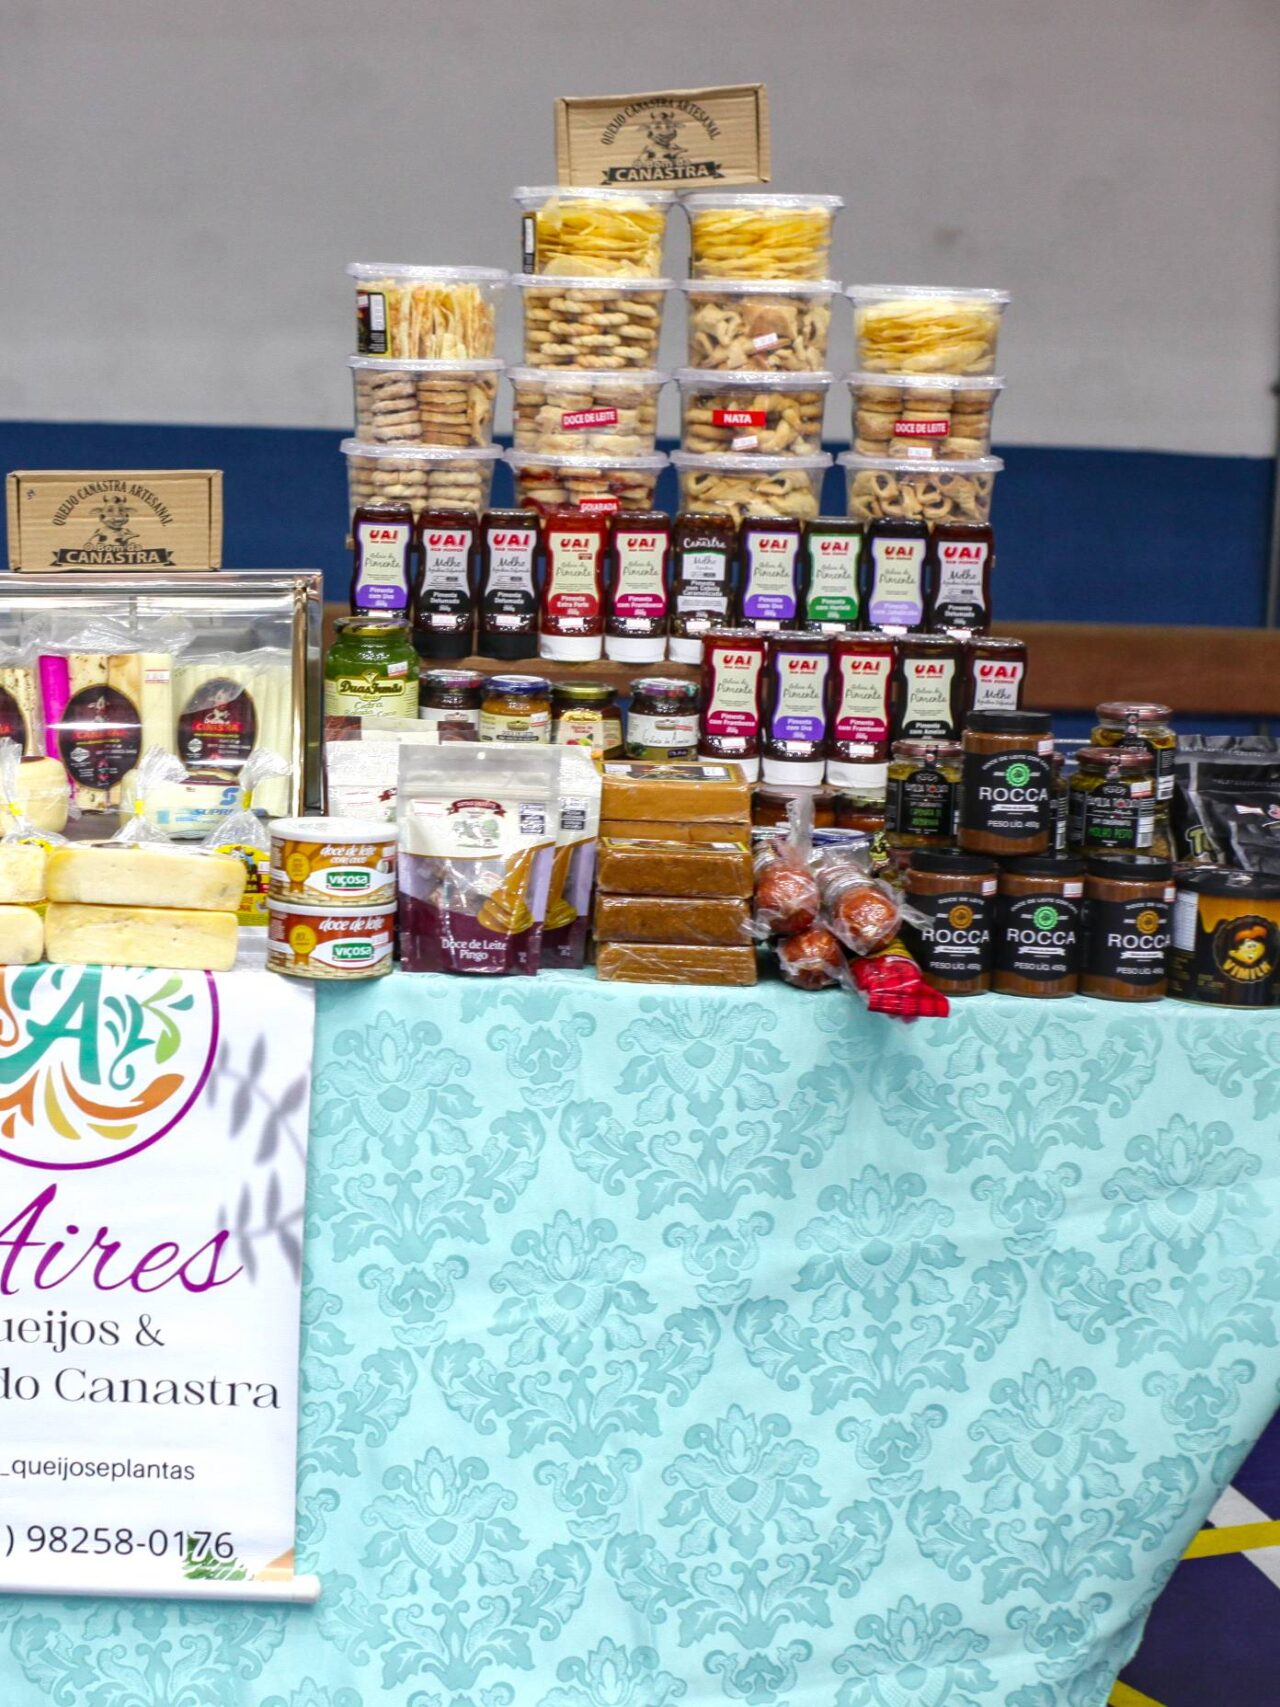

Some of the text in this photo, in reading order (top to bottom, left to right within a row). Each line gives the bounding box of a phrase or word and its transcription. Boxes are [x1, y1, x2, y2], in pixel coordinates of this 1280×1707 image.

[624, 98, 674, 119] CANASTRA
[675, 100, 721, 140] ARTESANAL
[615, 164, 709, 181] CANASTRA
[564, 410, 615, 425] DOCE DE LEITE
[723, 413, 752, 424] NATA
[895, 422, 946, 433] DOCE DE LEITE
[77, 480, 126, 500] CANASTRA
[128, 483, 173, 527] ARTESANAL
[369, 530, 398, 540] UAI
[429, 534, 466, 546] UAI
[493, 533, 530, 545] UAI
[560, 538, 590, 548] UAI
[627, 538, 656, 548] UAI
[759, 539, 788, 549] UAI
[821, 541, 849, 551] UAI
[884, 546, 913, 556] UAI
[944, 546, 981, 559] UAI
[66, 551, 160, 564] CANASTRA
[723, 655, 752, 665] UAI
[788, 660, 818, 670] UAI
[851, 661, 880, 671] UAI
[915, 664, 944, 674] UAI
[979, 665, 1018, 678] UAI
[340, 680, 371, 693] Duas
[979, 787, 1048, 801] ROCCA
[329, 875, 368, 888] viçosa
[922, 929, 990, 944] ROCCA
[1007, 928, 1076, 945] ROCCA
[442, 938, 508, 950] Doce de Leite
[335, 946, 372, 958] viçosa
[460, 949, 489, 961] Pingo
[1222, 959, 1272, 980] VIMILK
[134, 1313, 165, 1346] &
[54, 1367, 281, 1409] Canastra
[27, 1524, 234, 1560] 98258-0176
